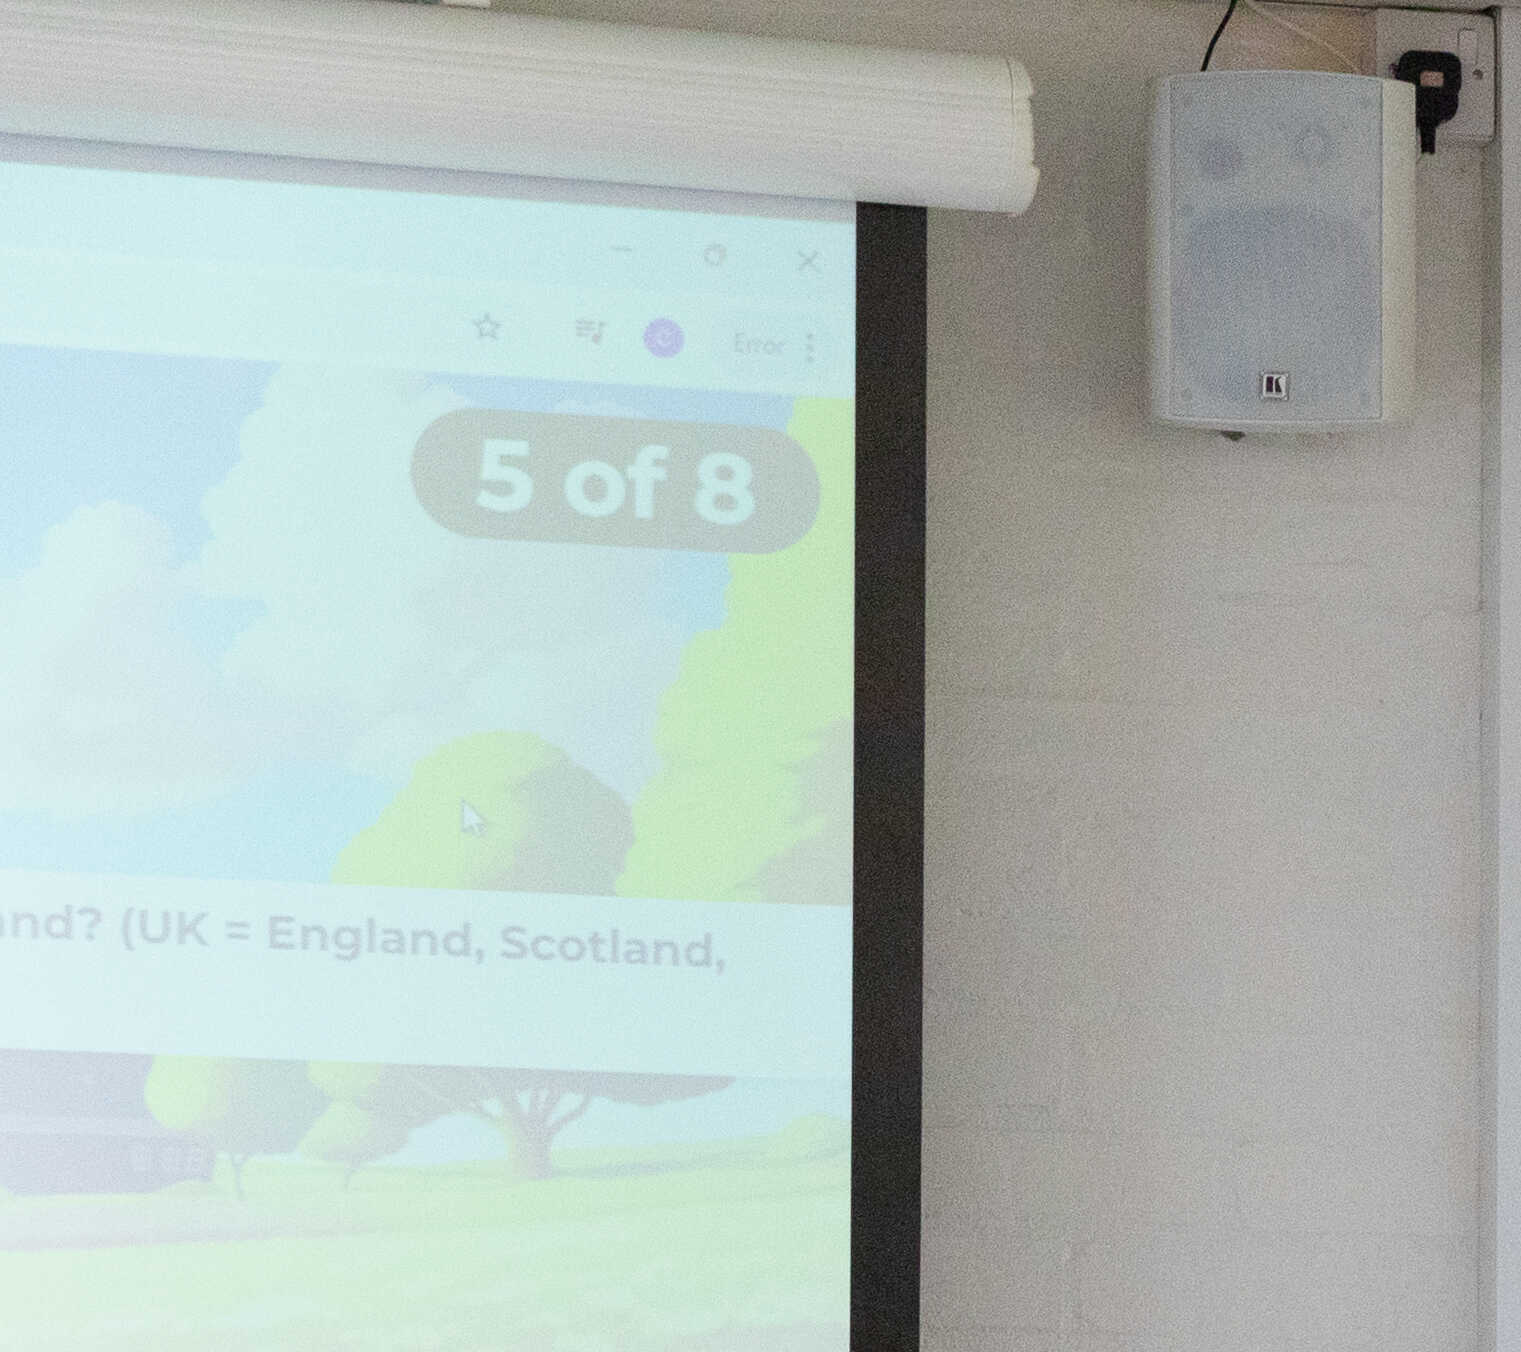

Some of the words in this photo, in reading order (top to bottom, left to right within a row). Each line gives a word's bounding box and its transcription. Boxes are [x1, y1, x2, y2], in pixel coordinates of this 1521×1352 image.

[733, 332, 785, 355] Error
[474, 437, 534, 513] 5
[562, 444, 669, 521] of
[693, 452, 757, 528] 8
[0, 904, 102, 942] nd?
[120, 908, 209, 951] (UK
[267, 915, 486, 965] England,
[499, 924, 727, 976] Scotland,
